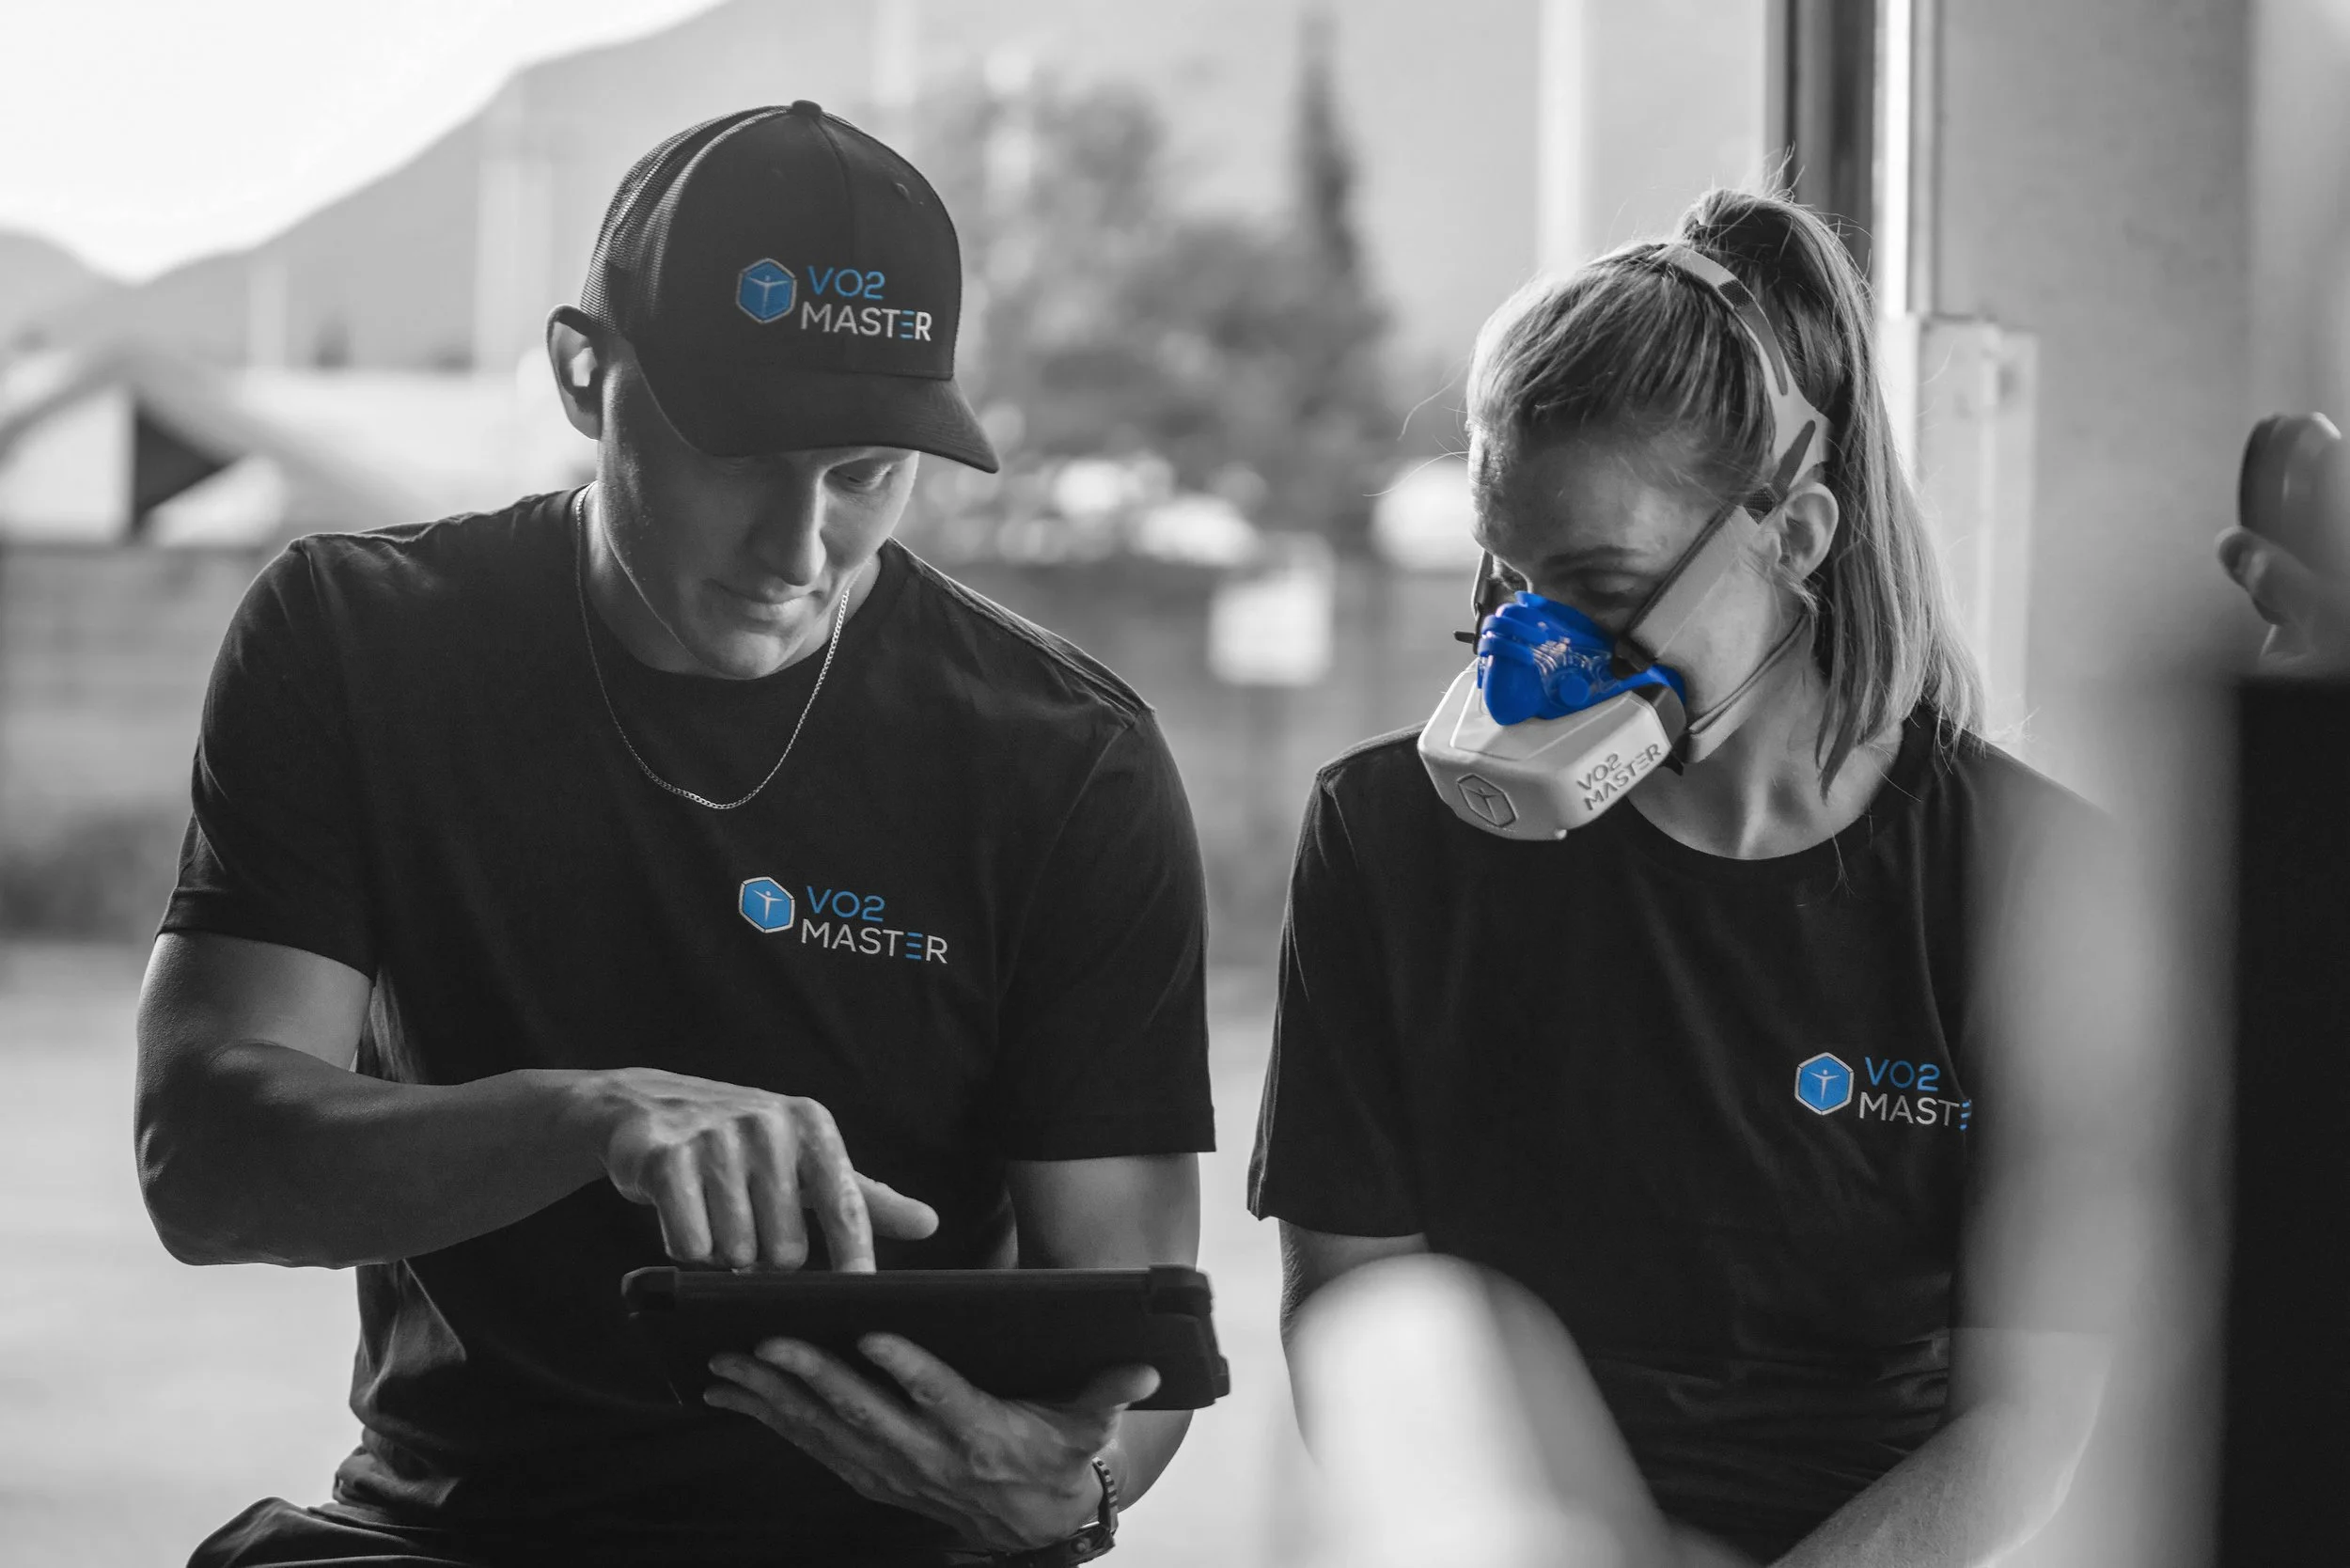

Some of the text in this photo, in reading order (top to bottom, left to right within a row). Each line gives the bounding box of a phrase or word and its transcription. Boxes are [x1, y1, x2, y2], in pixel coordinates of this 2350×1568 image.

[807, 265, 885, 300] VO2
[801, 301, 932, 341] MASTER
[1576, 752, 1622, 791] VO2
[1583, 743, 1662, 810] MASTER
[807, 886, 885, 922] VO2
[801, 918, 948, 964] MASTER
[1864, 1057, 1941, 1092] VO2
[1858, 1091, 1972, 1131] MASTE
